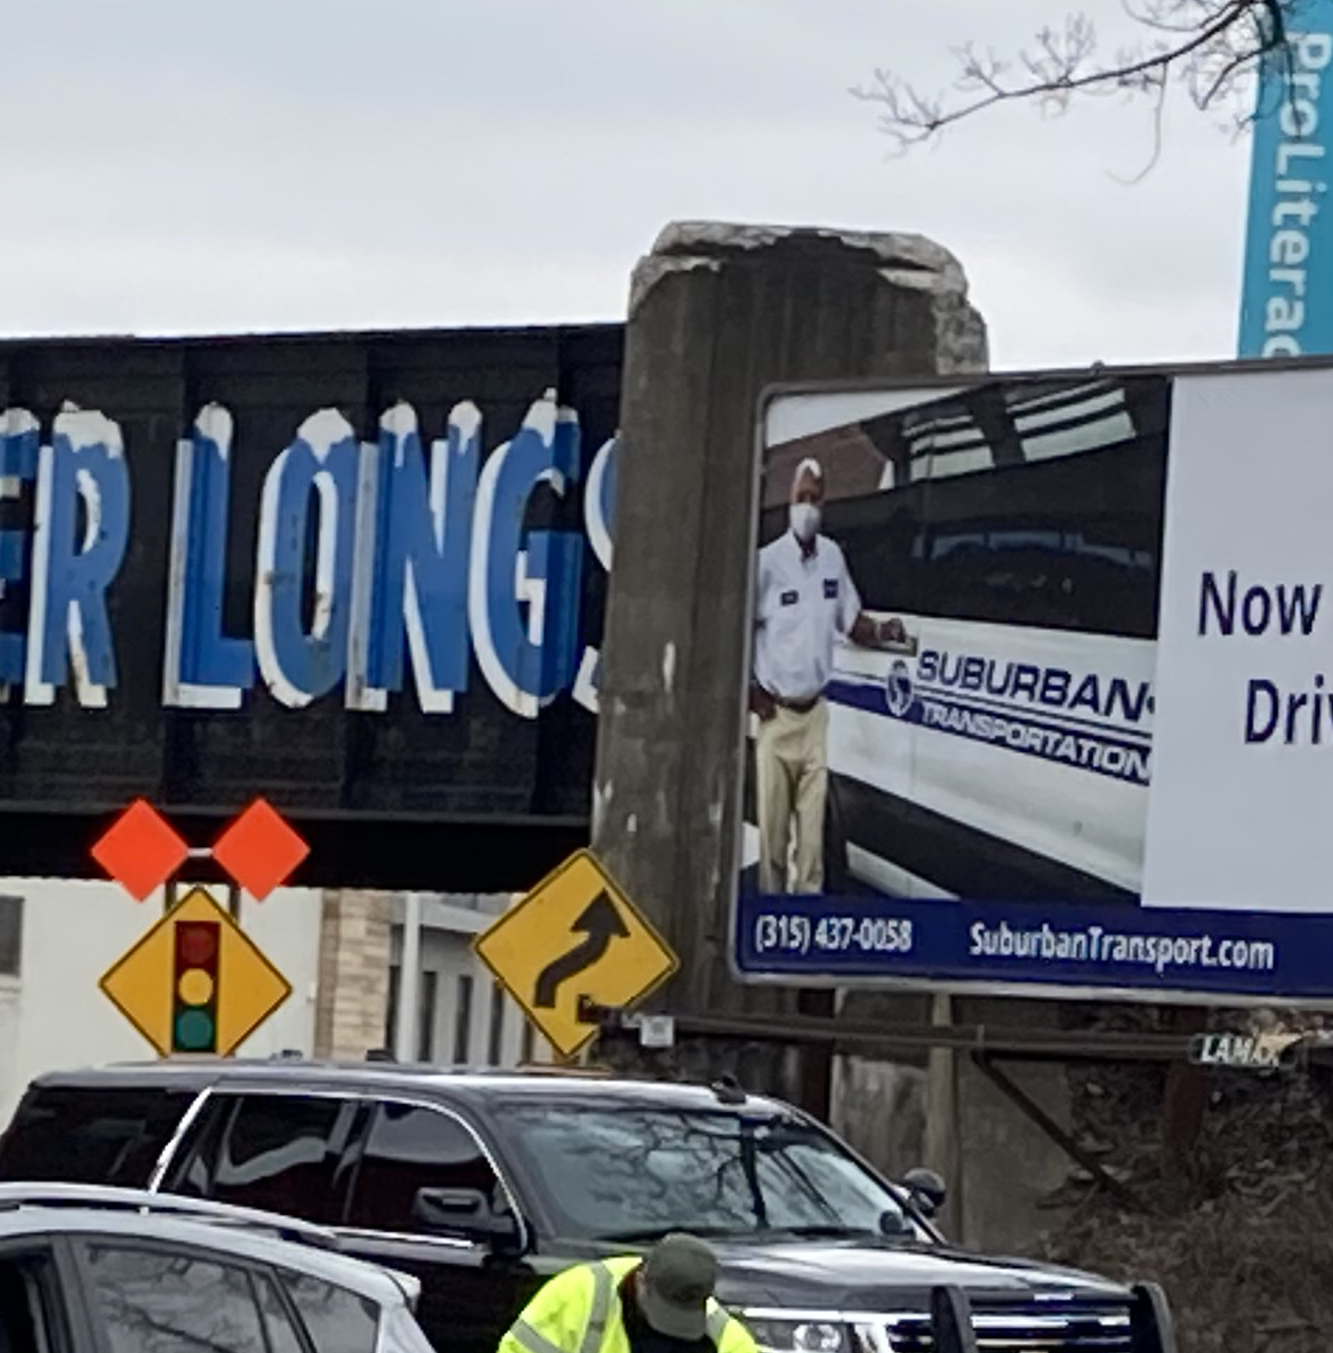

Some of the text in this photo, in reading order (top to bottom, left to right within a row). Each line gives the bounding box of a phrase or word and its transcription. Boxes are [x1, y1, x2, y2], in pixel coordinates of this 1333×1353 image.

[164, 387, 622, 719] LONG
[1198, 569, 1321, 635] Now
[918, 649, 1151, 722] SUBURBAN
[921, 700, 1153, 780] TRANSPORTATION
[755, 914, 810, 953] (315)
[814, 917, 913, 952] 437-0058
[969, 921, 1275, 973] SuburbanTransport.com
